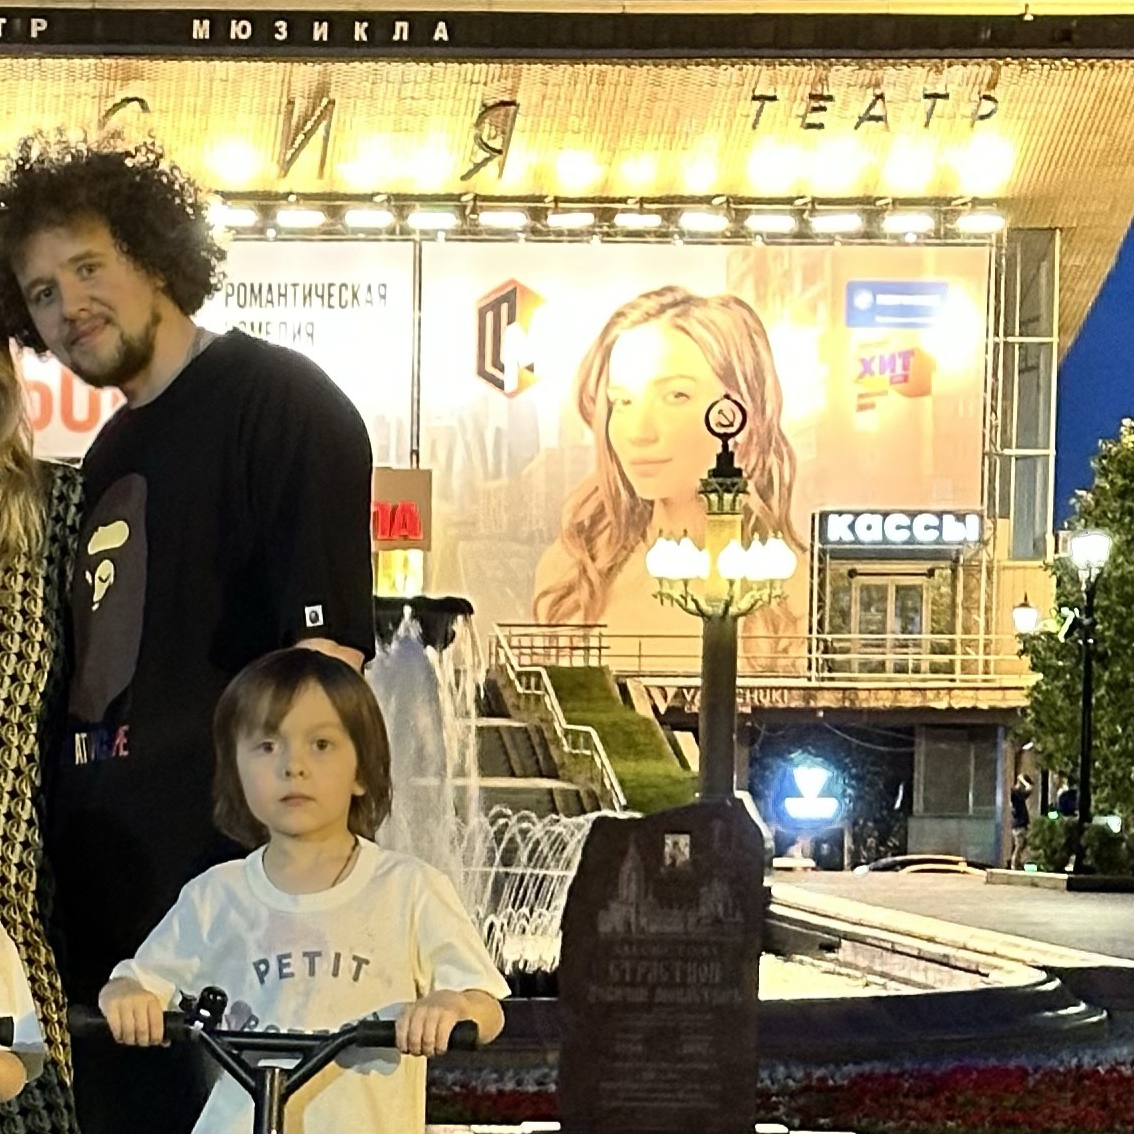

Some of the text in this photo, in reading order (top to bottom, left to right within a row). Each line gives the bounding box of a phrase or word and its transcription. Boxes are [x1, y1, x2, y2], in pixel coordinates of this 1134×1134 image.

[192, 19, 449, 43] МЮЗИКЛА
[751, 92, 999, 131] ТЕАТР
[225, 282, 387, 309] РОМАНТИЧЕСКАЯ
[253, 951, 370, 985] PETIT
